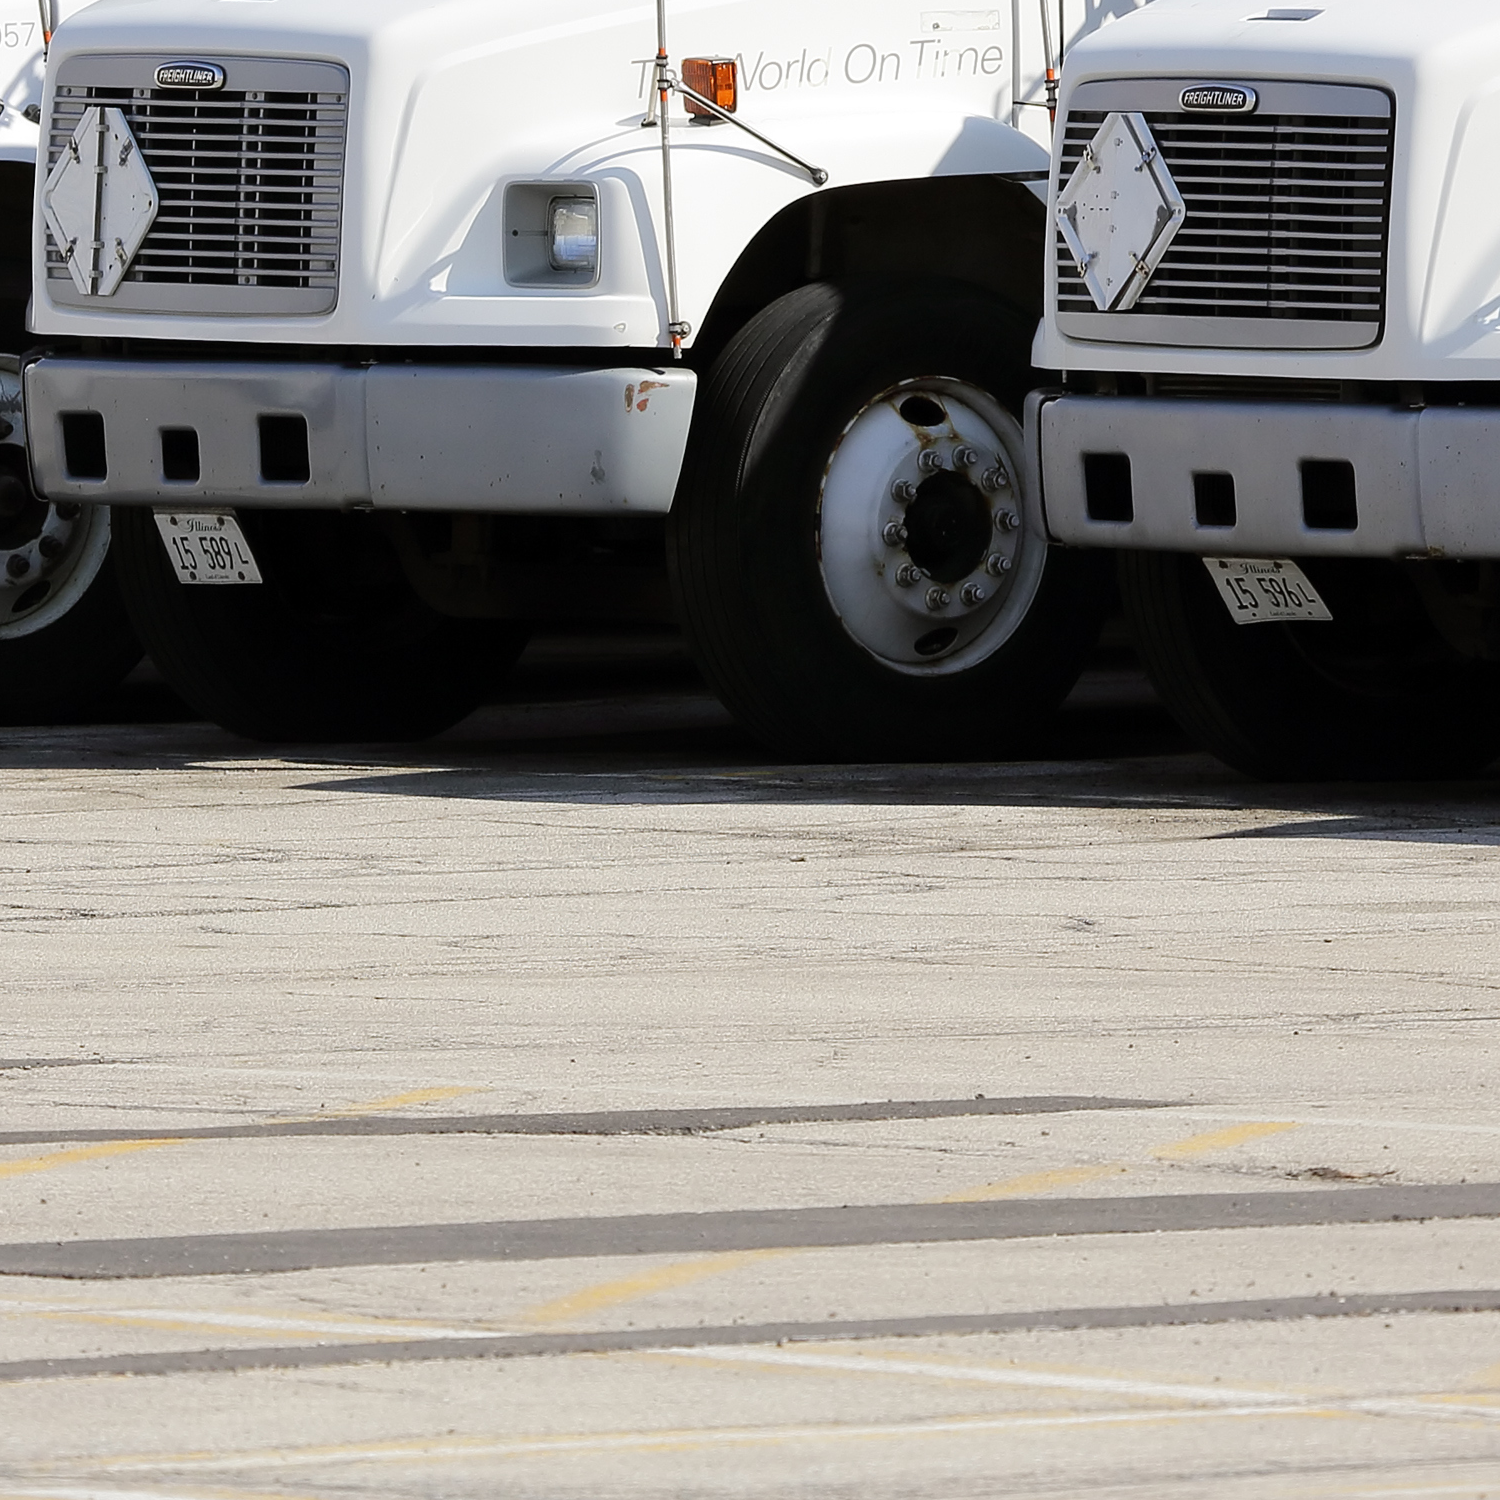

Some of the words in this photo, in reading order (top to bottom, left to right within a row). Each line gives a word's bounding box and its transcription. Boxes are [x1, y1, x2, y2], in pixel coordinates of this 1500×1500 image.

[160, 68, 214, 83] FREIGHTLINER
[844, 43, 901, 84] On
[1183, 91, 1244, 105] FREIGHTLINER
[172, 536, 197, 570] 15
[1225, 577, 1259, 610] 15
